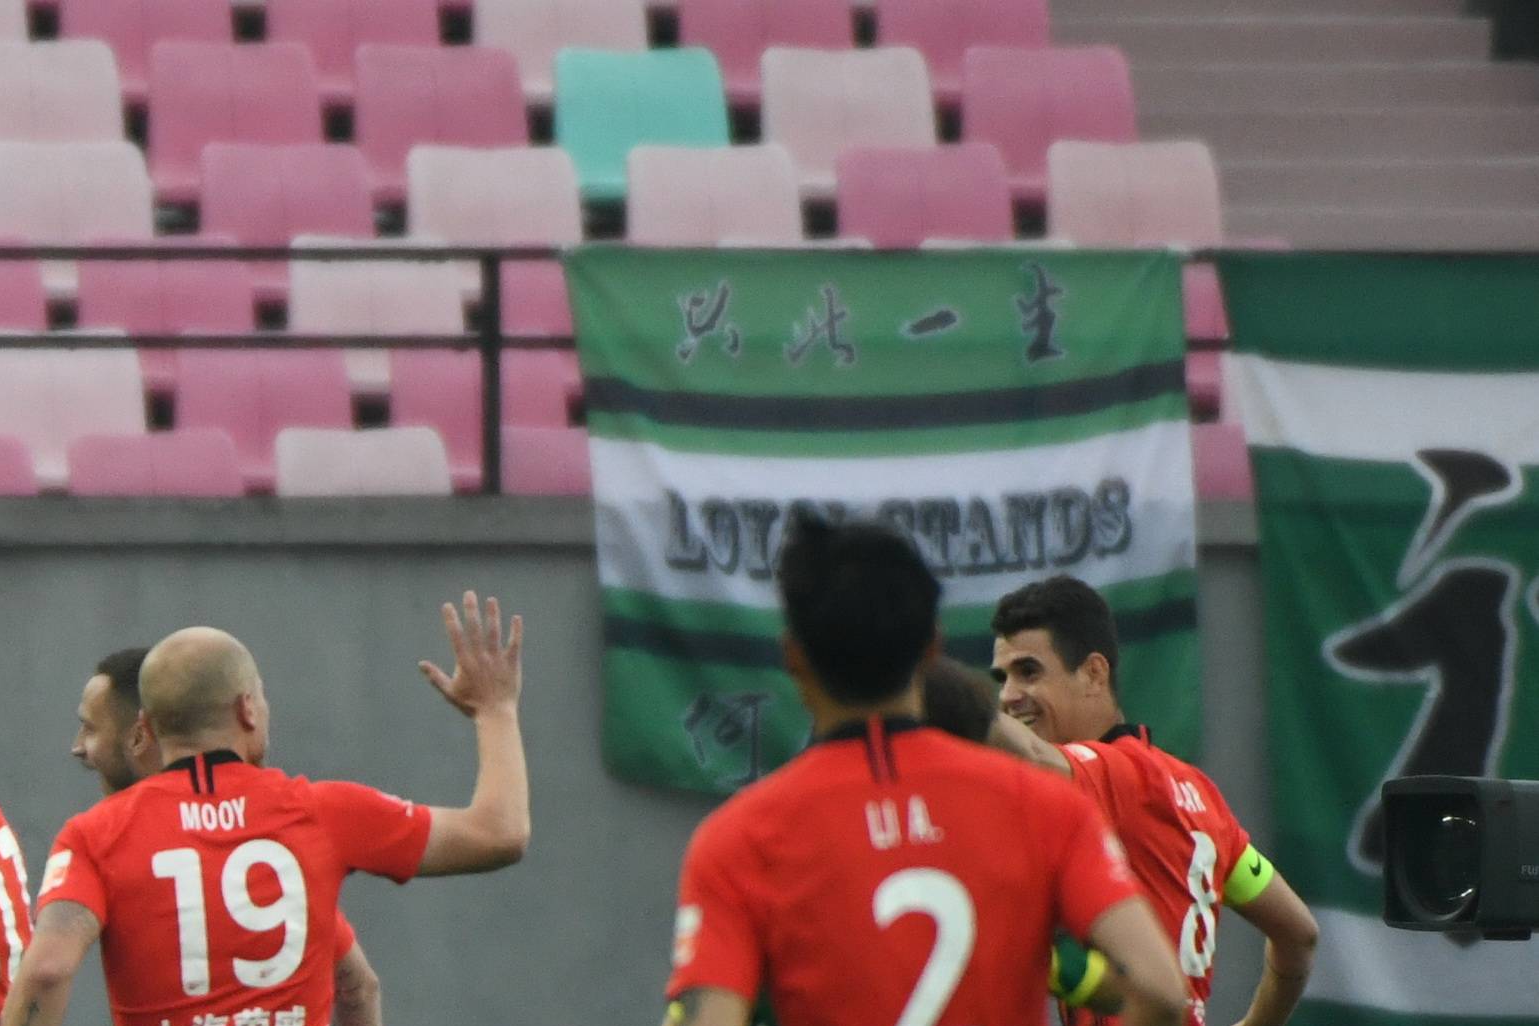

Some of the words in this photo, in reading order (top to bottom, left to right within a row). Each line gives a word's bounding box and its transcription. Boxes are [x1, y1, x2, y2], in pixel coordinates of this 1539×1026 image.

[664, 490, 850, 580] LOY
[180, 797, 246, 830] MOOY
[151, 838, 308, 996] 19
[1179, 830, 1218, 978] 8
